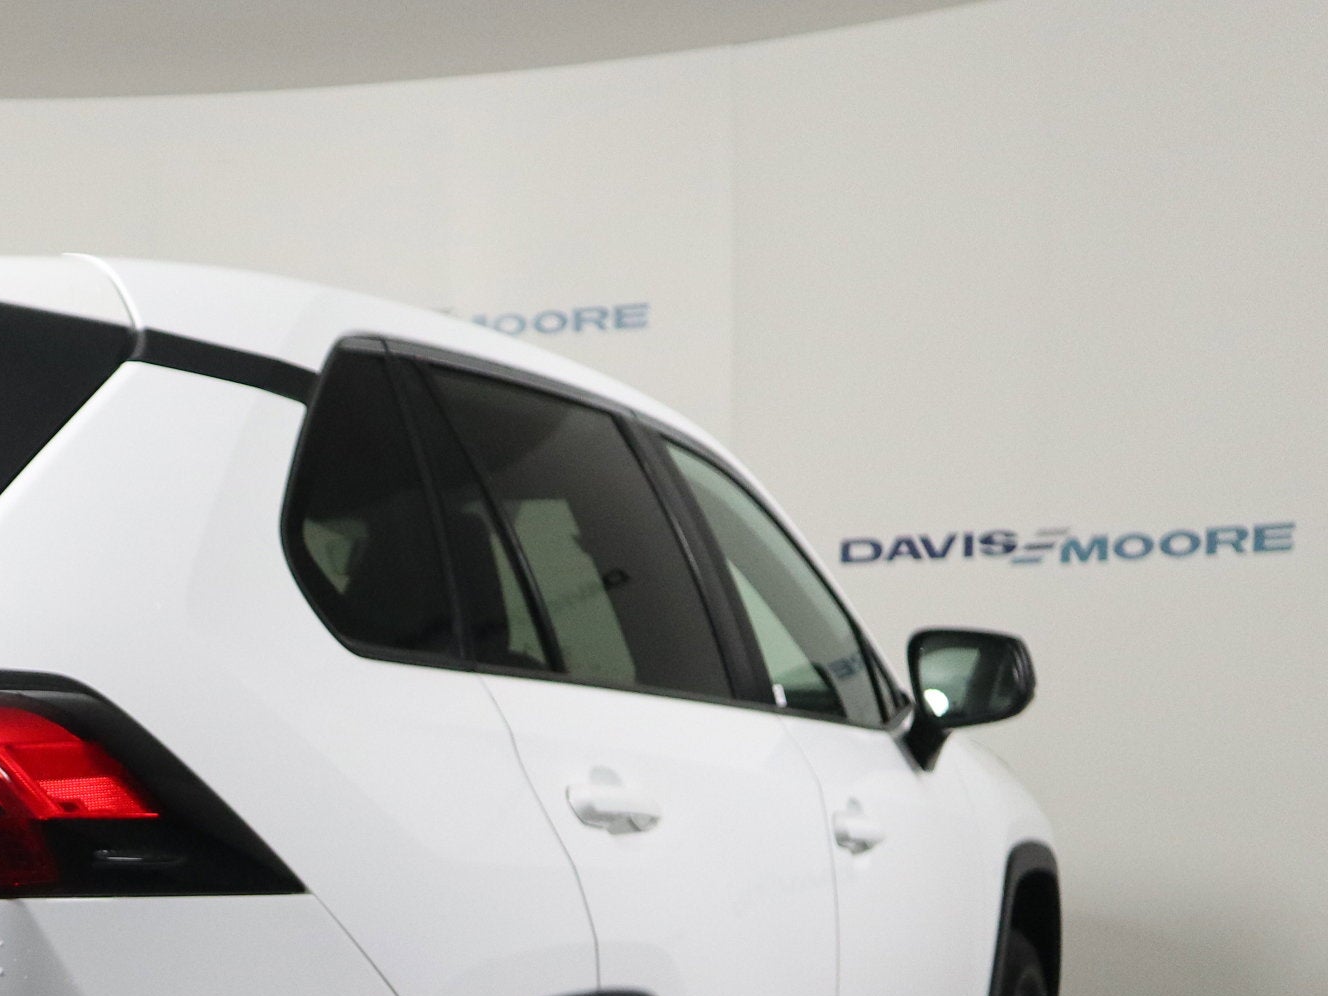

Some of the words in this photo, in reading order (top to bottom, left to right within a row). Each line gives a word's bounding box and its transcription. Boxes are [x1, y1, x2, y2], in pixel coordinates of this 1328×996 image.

[470, 302, 650, 336] OORE
[840, 529, 1018, 563] DAVIS
[1059, 522, 1296, 563] MOORE
